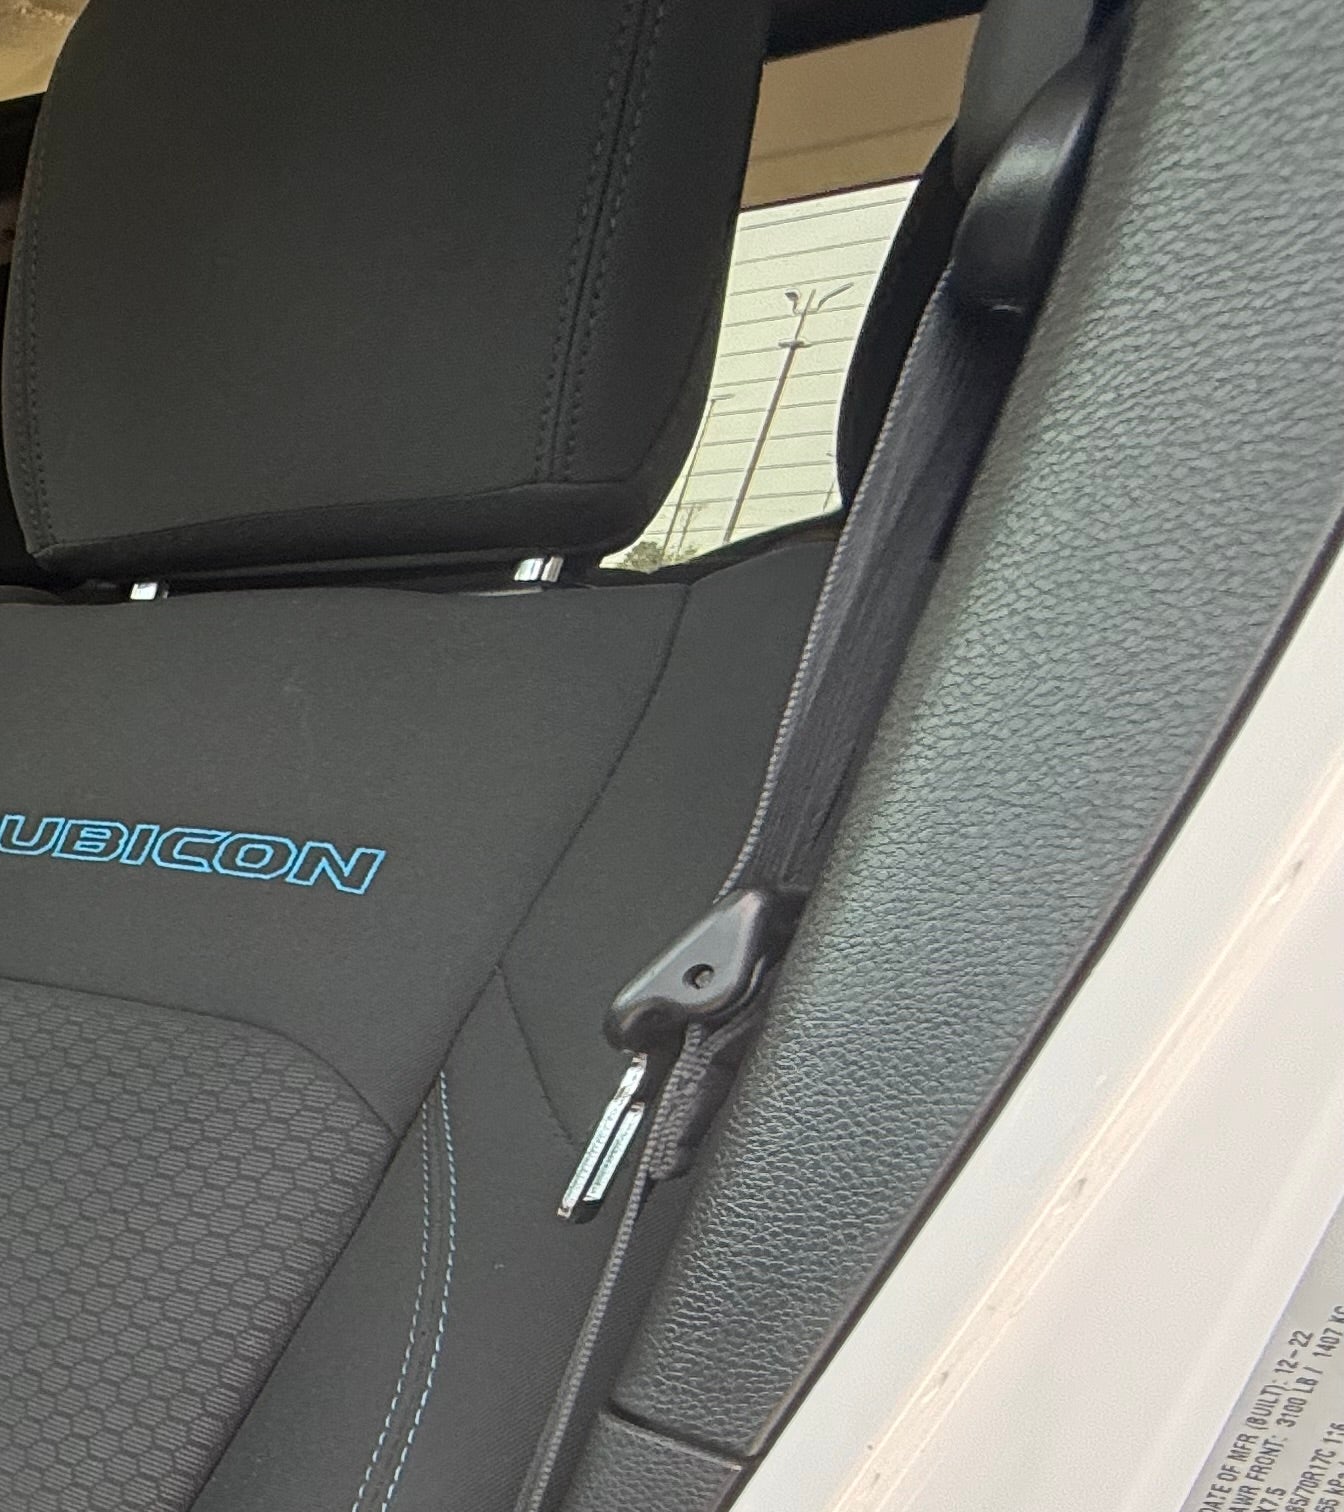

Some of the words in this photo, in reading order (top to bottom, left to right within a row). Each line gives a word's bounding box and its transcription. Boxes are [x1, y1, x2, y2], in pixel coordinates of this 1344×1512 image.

[1275, 1330, 1314, 1374] 12-22
[1245, 1380, 1288, 1430] (BUILT):
[1245, 1435, 1287, 1482] FRONT:
[1276, 1397, 1308, 1428] 3100
[1293, 1377, 1319, 1394] LB
[1312, 1328, 1343, 1358] 1407
[1227, 1433, 1259, 1462] MFR
[1217, 1465, 1242, 1482] OF
